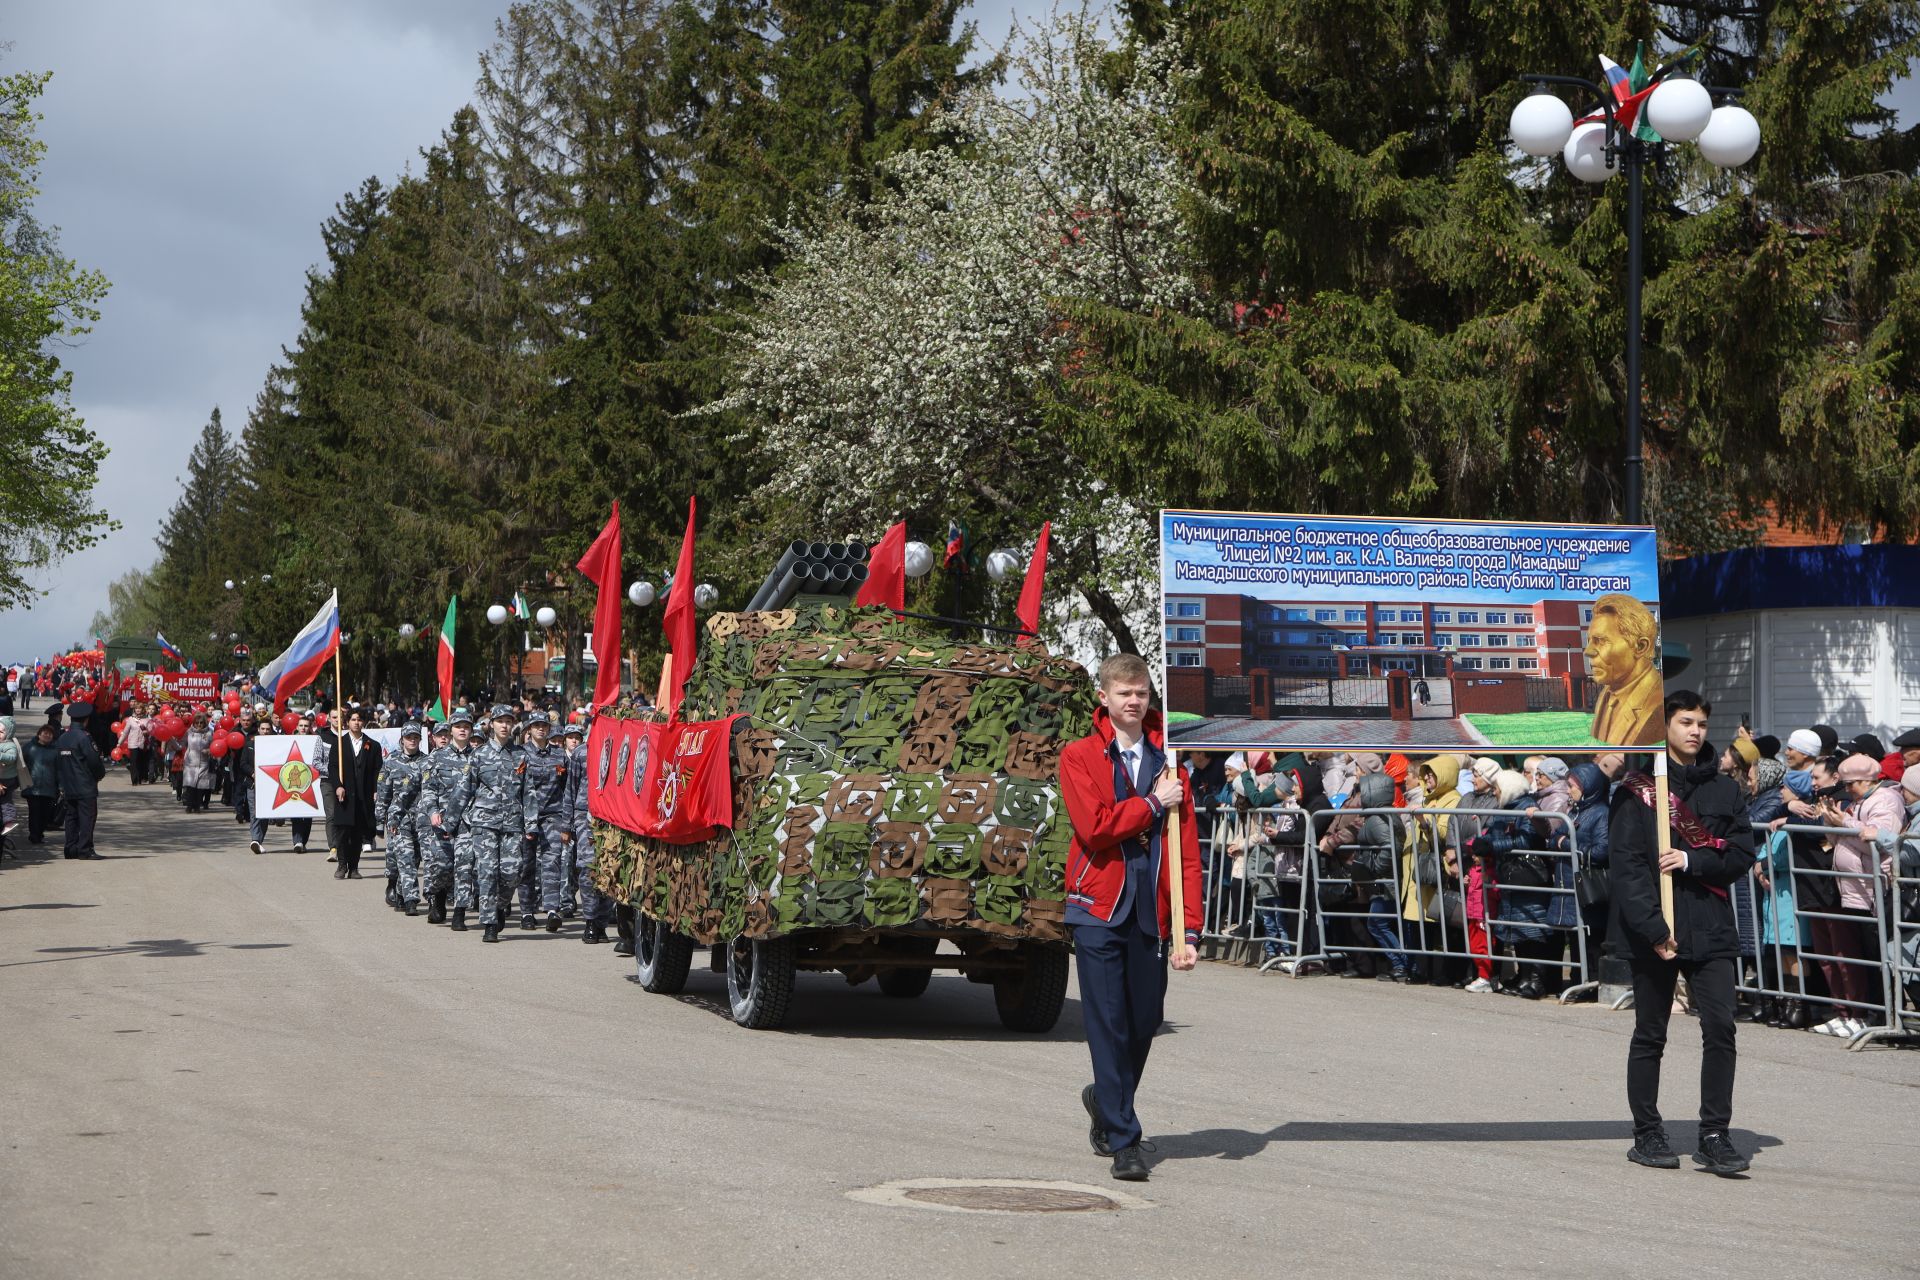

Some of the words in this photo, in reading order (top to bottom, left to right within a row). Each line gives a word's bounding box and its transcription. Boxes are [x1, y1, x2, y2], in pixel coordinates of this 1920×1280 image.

[1172, 521, 1292, 545] Муниципальное
[1294, 525, 1380, 548] бюджетное
[1381, 529, 1543, 552] общеобразовательное
[1545, 538, 1631, 556] учреждение
[1215, 542, 1271, 565] "Лицей
[1274, 545, 1303, 564] №2
[1305, 550, 1332, 565] им.
[1334, 551, 1358, 566] ак.
[1360, 548, 1391, 566] К.А.
[1394, 549, 1455, 568] Валиева
[1457, 553, 1507, 573] города
[1510, 553, 1588, 573] Мамадыш"
[1175, 561, 1289, 583] Мамадышского
[1291, 568, 1415, 588] муниципального
[1417, 568, 1469, 590] района
[1471, 571, 1555, 593] Республики
[1557, 572, 1631, 594] Татарстан
[143, 674, 164, 697] 79
[178, 677, 213, 687] ВЕЛИКОЙ
[179, 686, 216, 697] ПОБЕДЫ!
